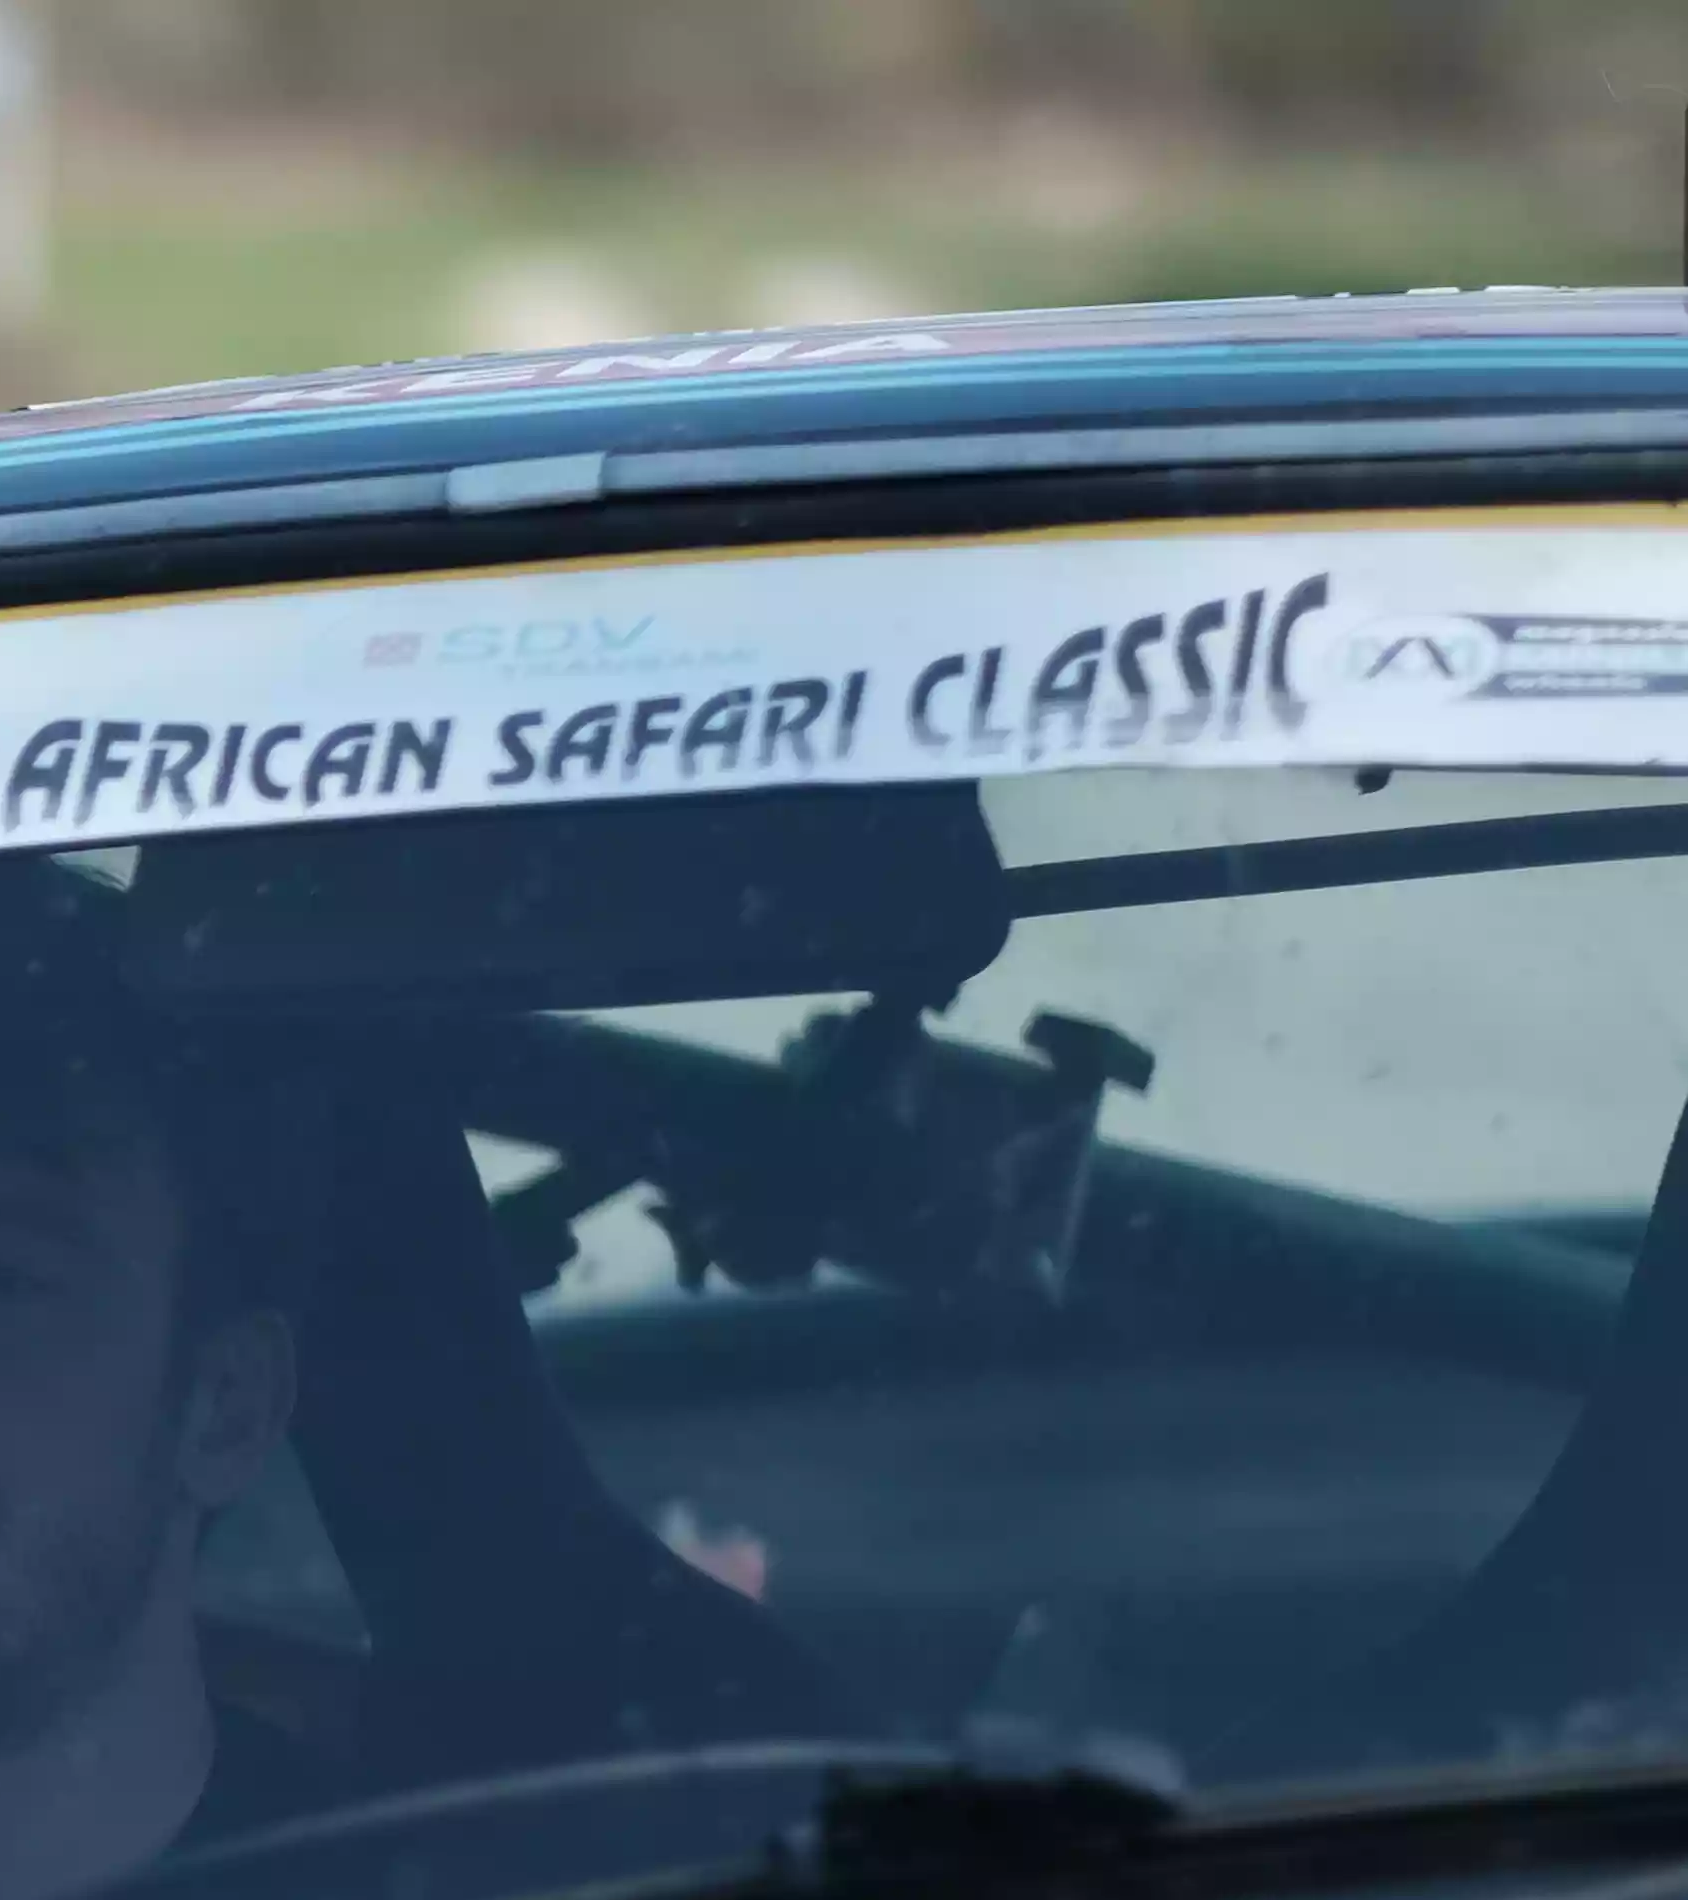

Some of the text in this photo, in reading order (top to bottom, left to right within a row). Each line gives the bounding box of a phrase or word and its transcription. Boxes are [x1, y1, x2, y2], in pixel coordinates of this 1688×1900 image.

[2, 714, 458, 833] AFRICAN
[487, 669, 873, 788] SAFARI
[907, 570, 1332, 763] CLASSIC
[435, 613, 657, 666] SDV
